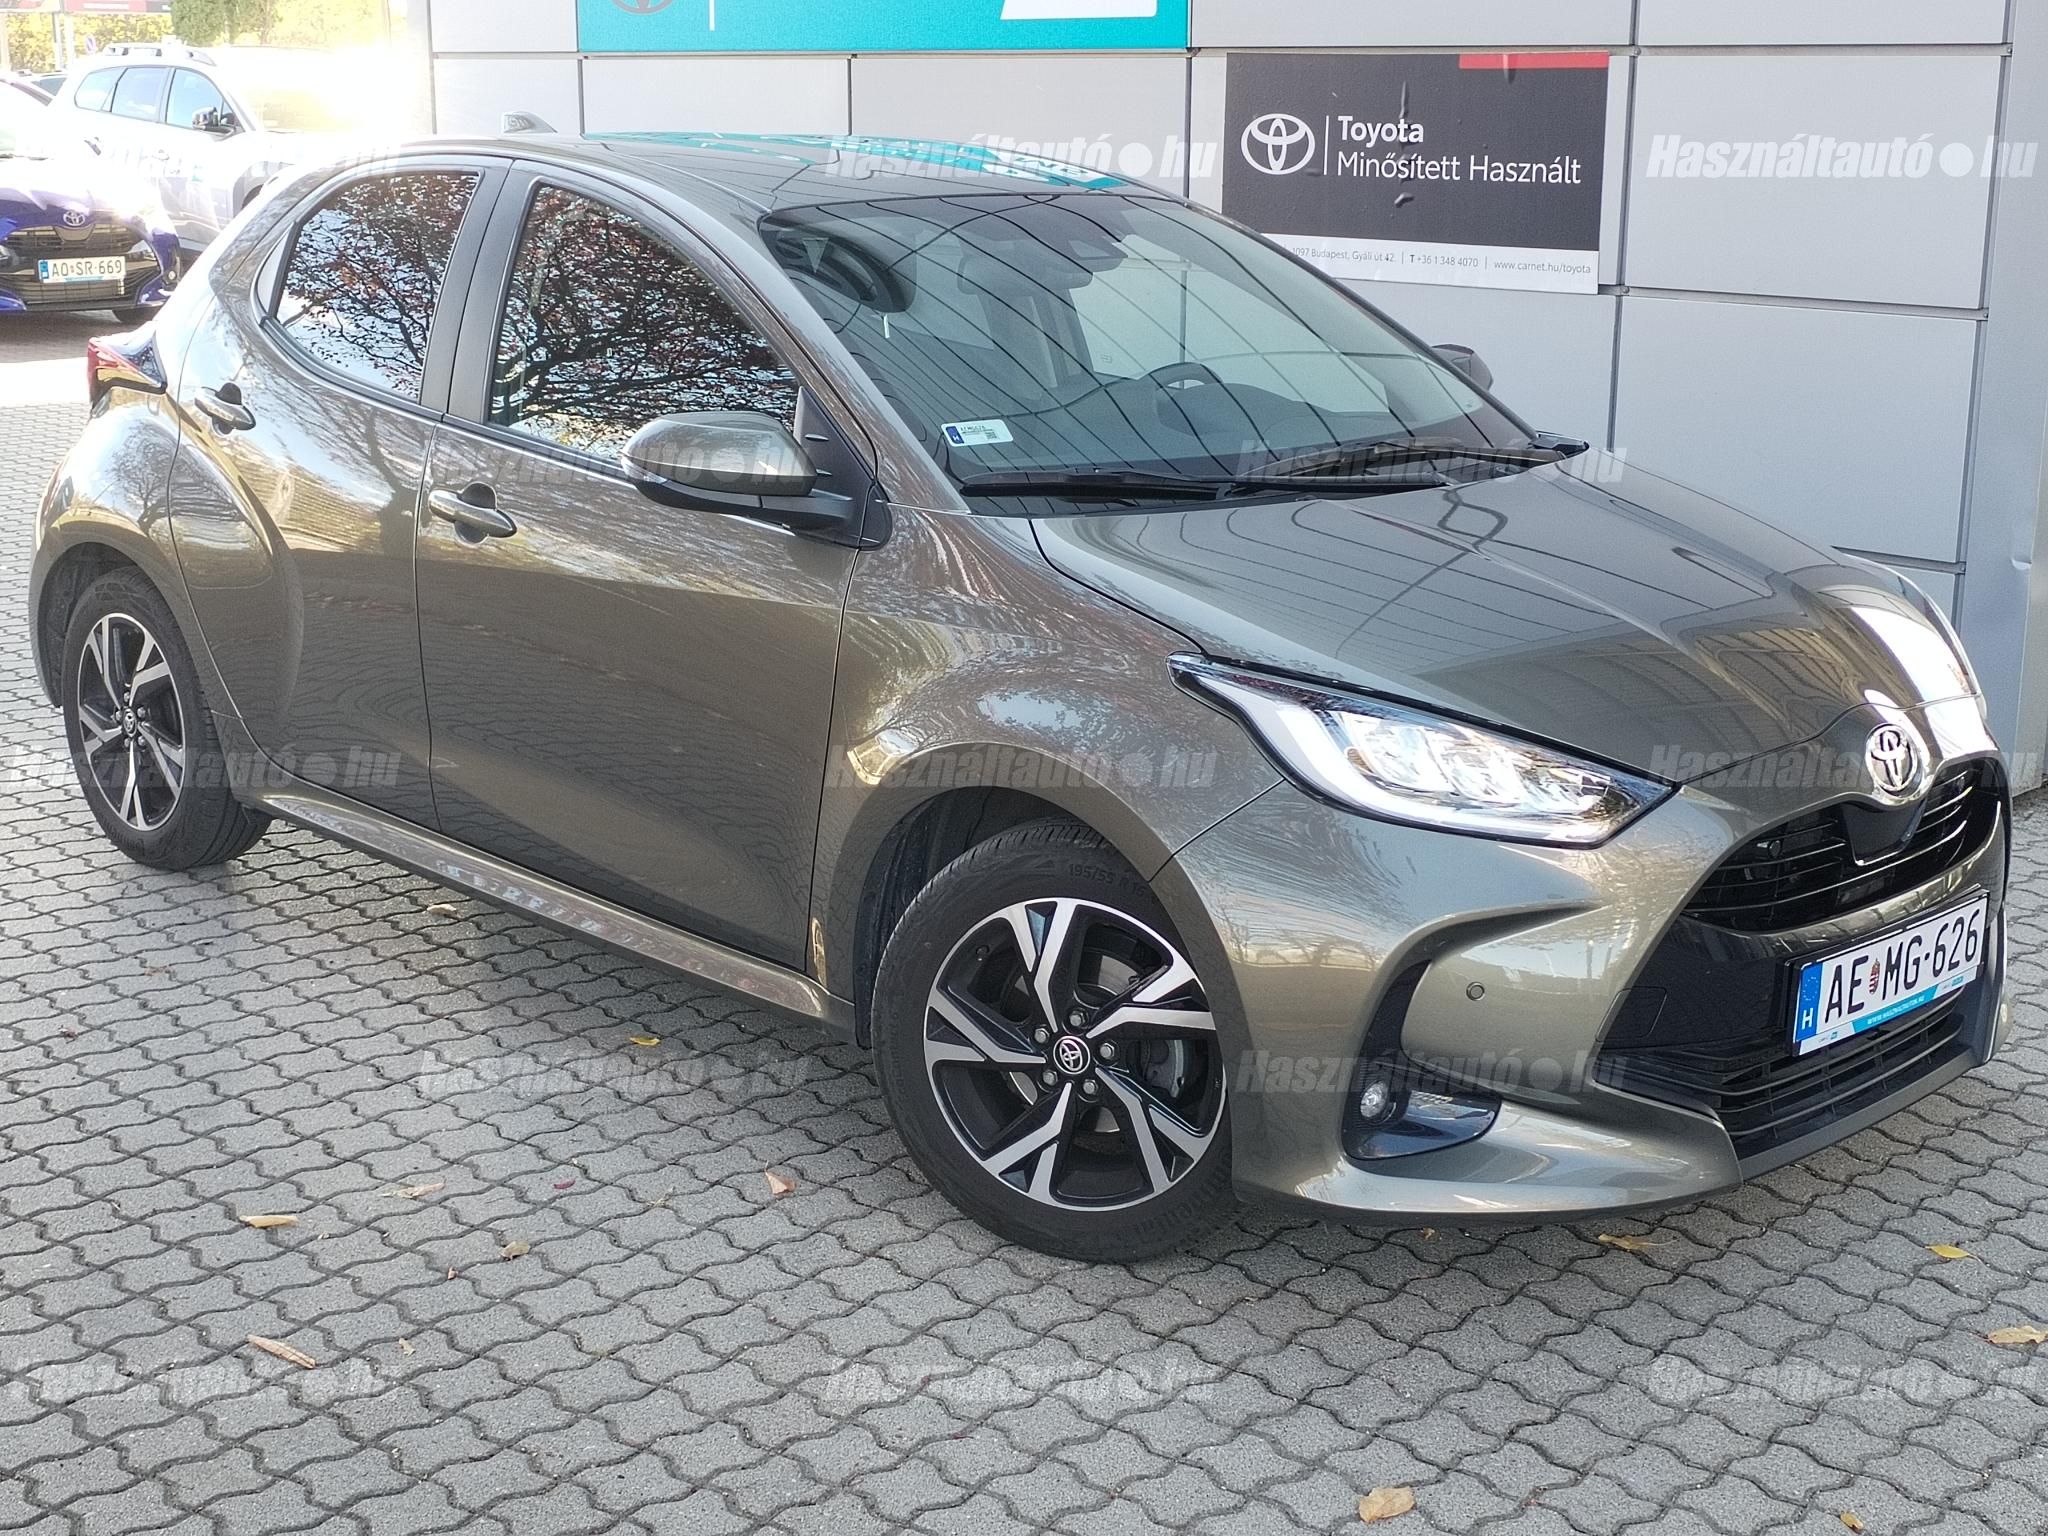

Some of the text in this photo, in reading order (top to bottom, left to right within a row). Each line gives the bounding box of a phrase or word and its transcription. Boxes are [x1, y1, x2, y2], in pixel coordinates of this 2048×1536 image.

[1337, 114, 1424, 148] Toyota
[1337, 150, 1581, 185] Minősített Használt
[1409, 253, 1416, 264] T
[1439, 256, 1456, 267] 348
[1457, 256, 1479, 268] 4070
[1493, 261, 1591, 274] www.carnet.hu/toyota
[1824, 955, 1869, 1023] AE
[1801, 1006, 1815, 1031] H
